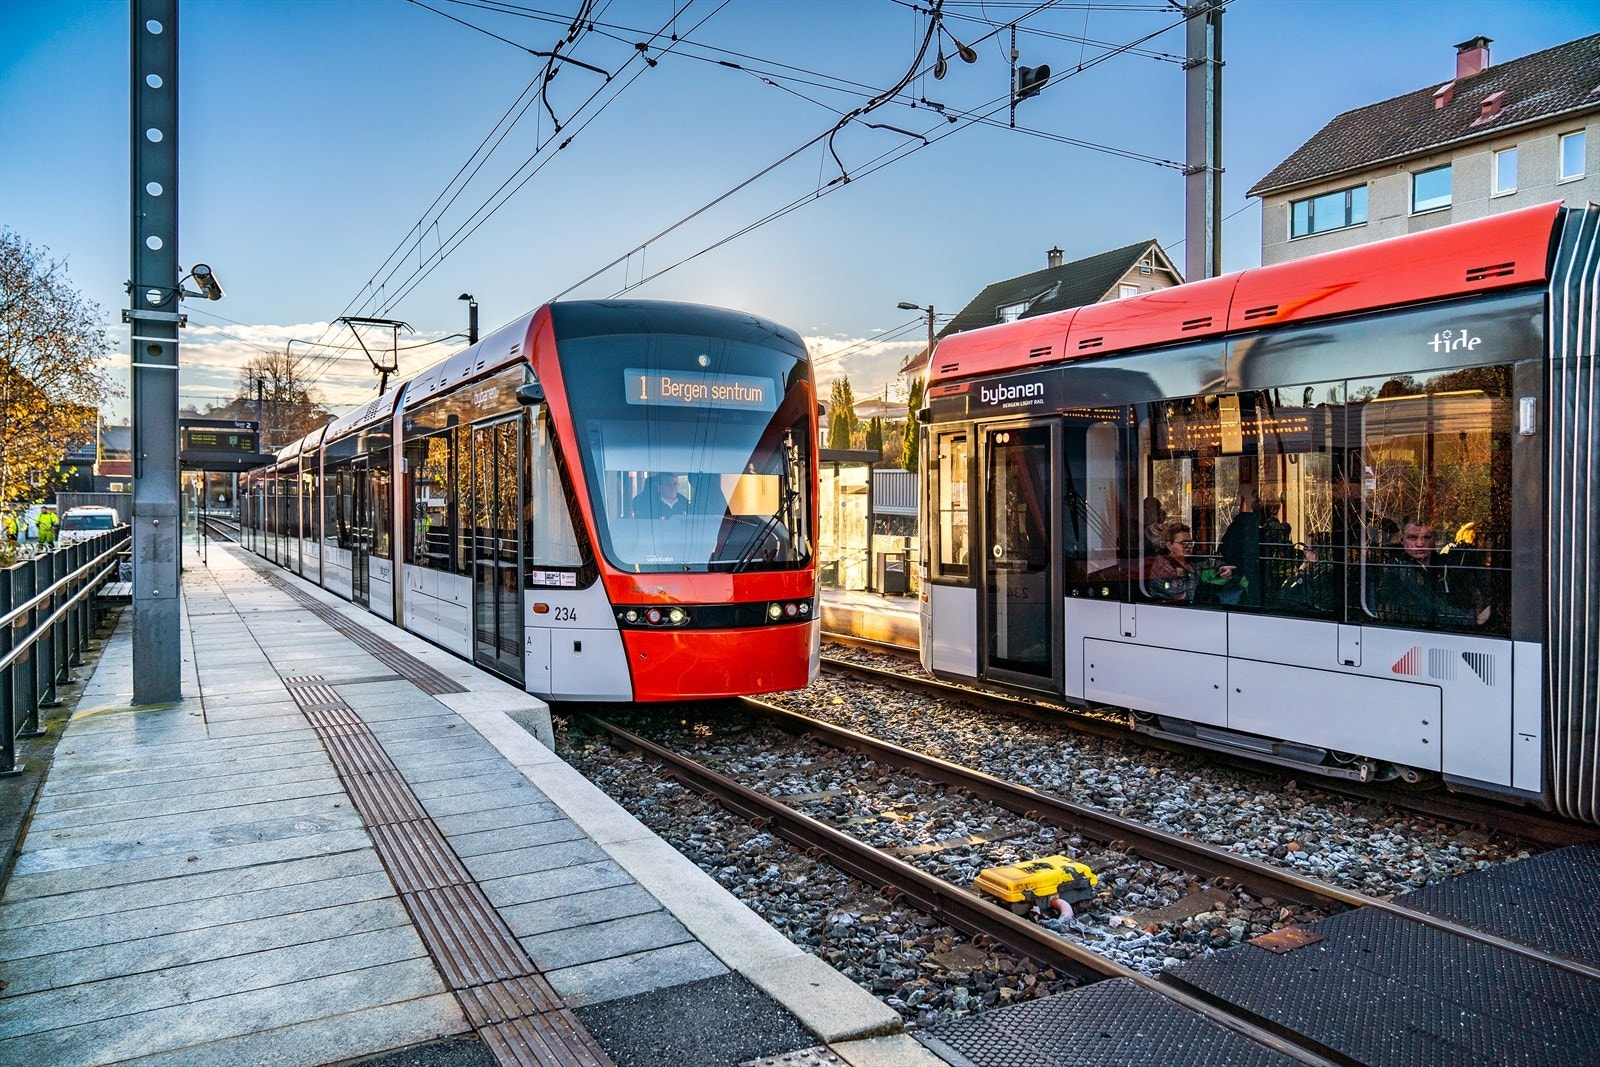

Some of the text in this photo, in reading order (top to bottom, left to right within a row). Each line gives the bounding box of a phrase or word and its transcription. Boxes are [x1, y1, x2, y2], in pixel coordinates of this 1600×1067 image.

[1427, 330, 1482, 353] tide
[640, 376, 762, 402] 1 Bergen sentrum
[981, 382, 1044, 405] bybanen
[555, 606, 577, 621] 234
